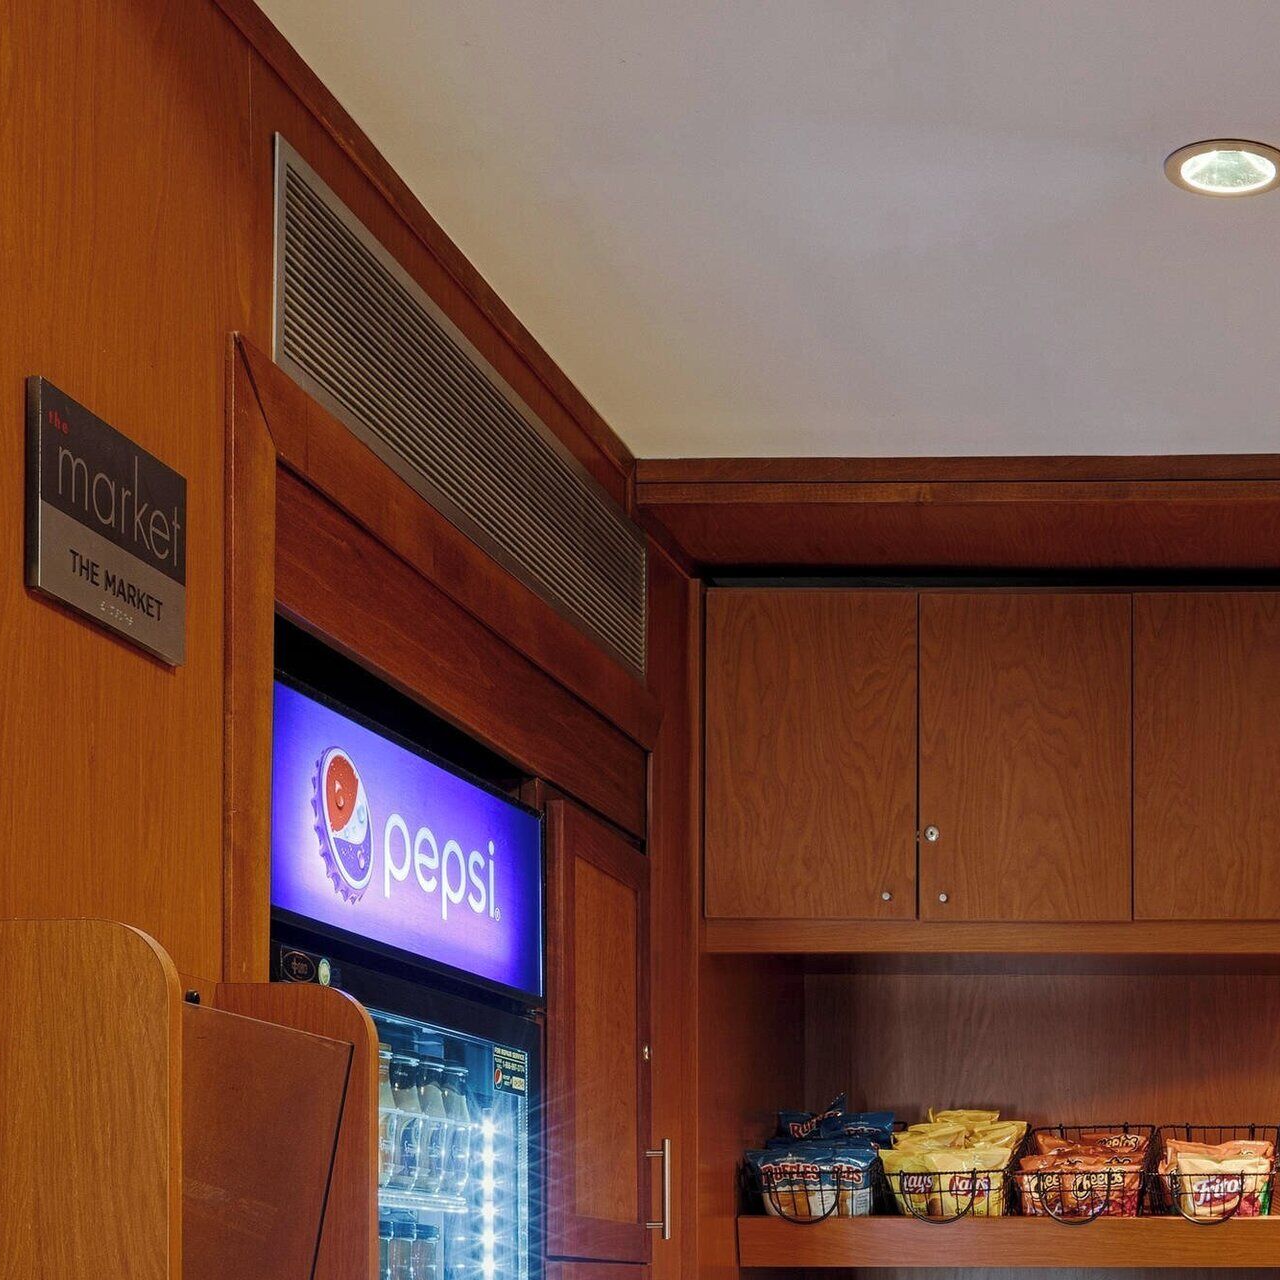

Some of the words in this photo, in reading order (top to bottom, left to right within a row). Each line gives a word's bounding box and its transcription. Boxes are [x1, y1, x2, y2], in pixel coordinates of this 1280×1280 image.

[48, 410, 69, 435] the
[58, 445, 181, 568] market
[69, 549, 100, 587] THE
[104, 569, 163, 621] MARKET
[383, 812, 496, 921] pepsi
